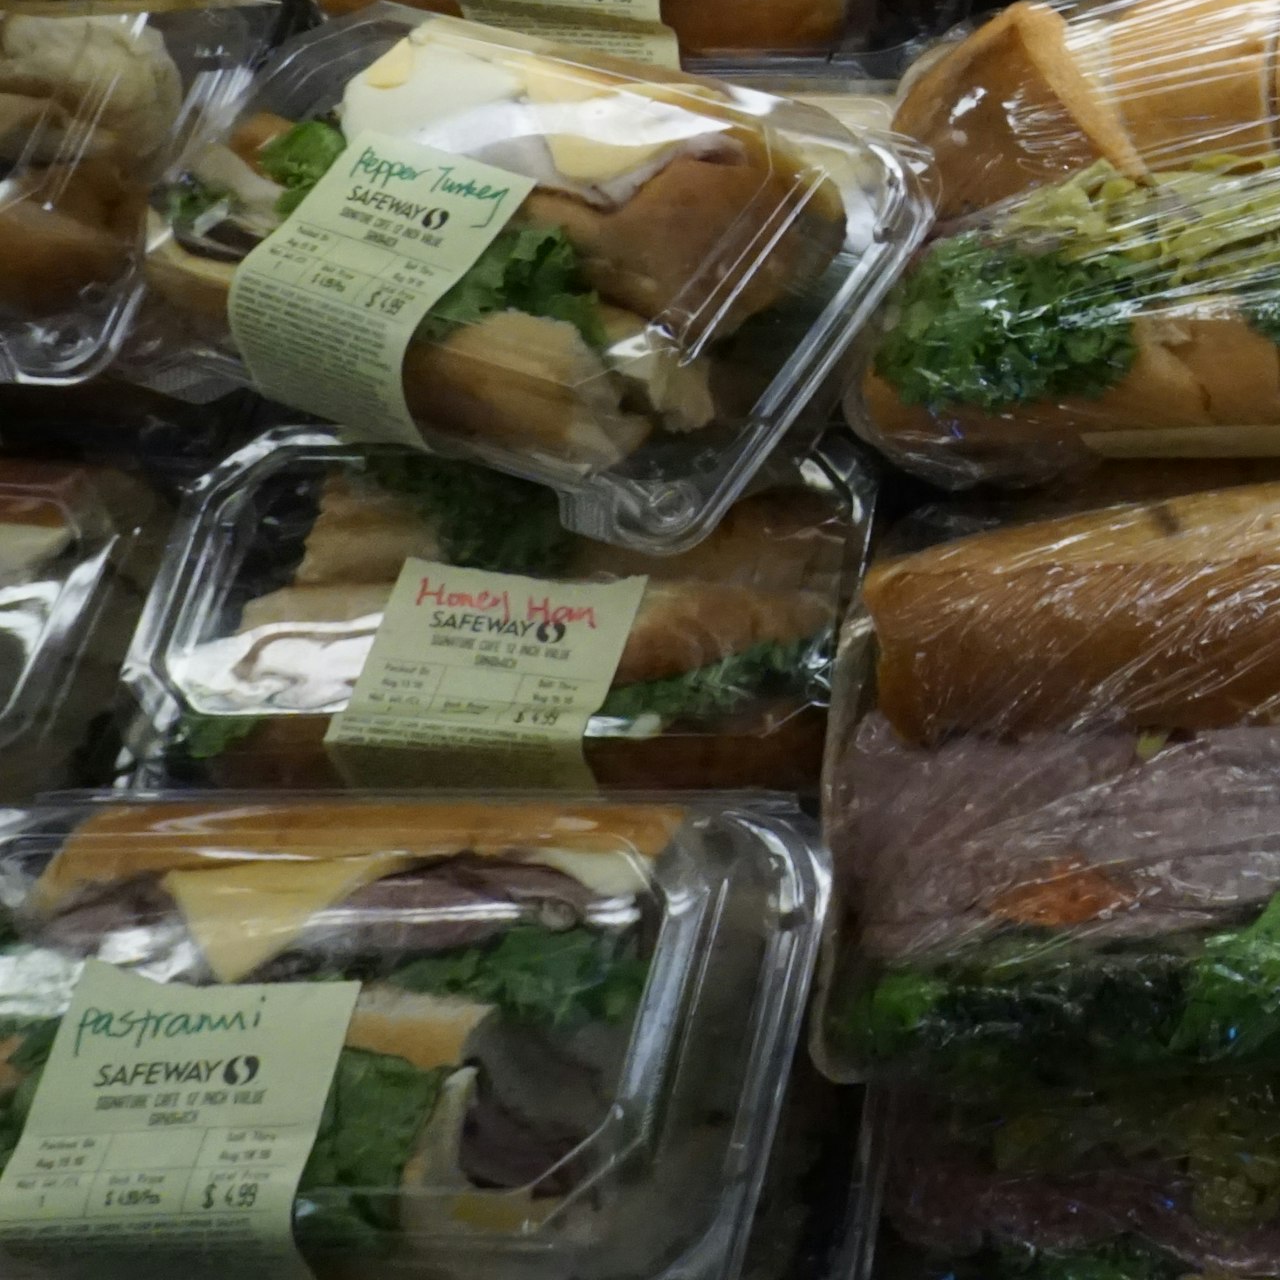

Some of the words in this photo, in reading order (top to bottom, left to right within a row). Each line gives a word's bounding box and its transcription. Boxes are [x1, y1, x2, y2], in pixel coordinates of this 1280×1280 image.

[346, 186, 427, 219] SAFEWAY
[350, 146, 431, 189] Pepper
[430, 166, 511, 229] Turkey
[415, 576, 512, 625] Honey
[527, 595, 596, 630] Ham
[429, 610, 535, 637] SAFEWAY
[94, 1060, 222, 1087] SAFEWAY
[225, 1183, 259, 1207] 4.99
